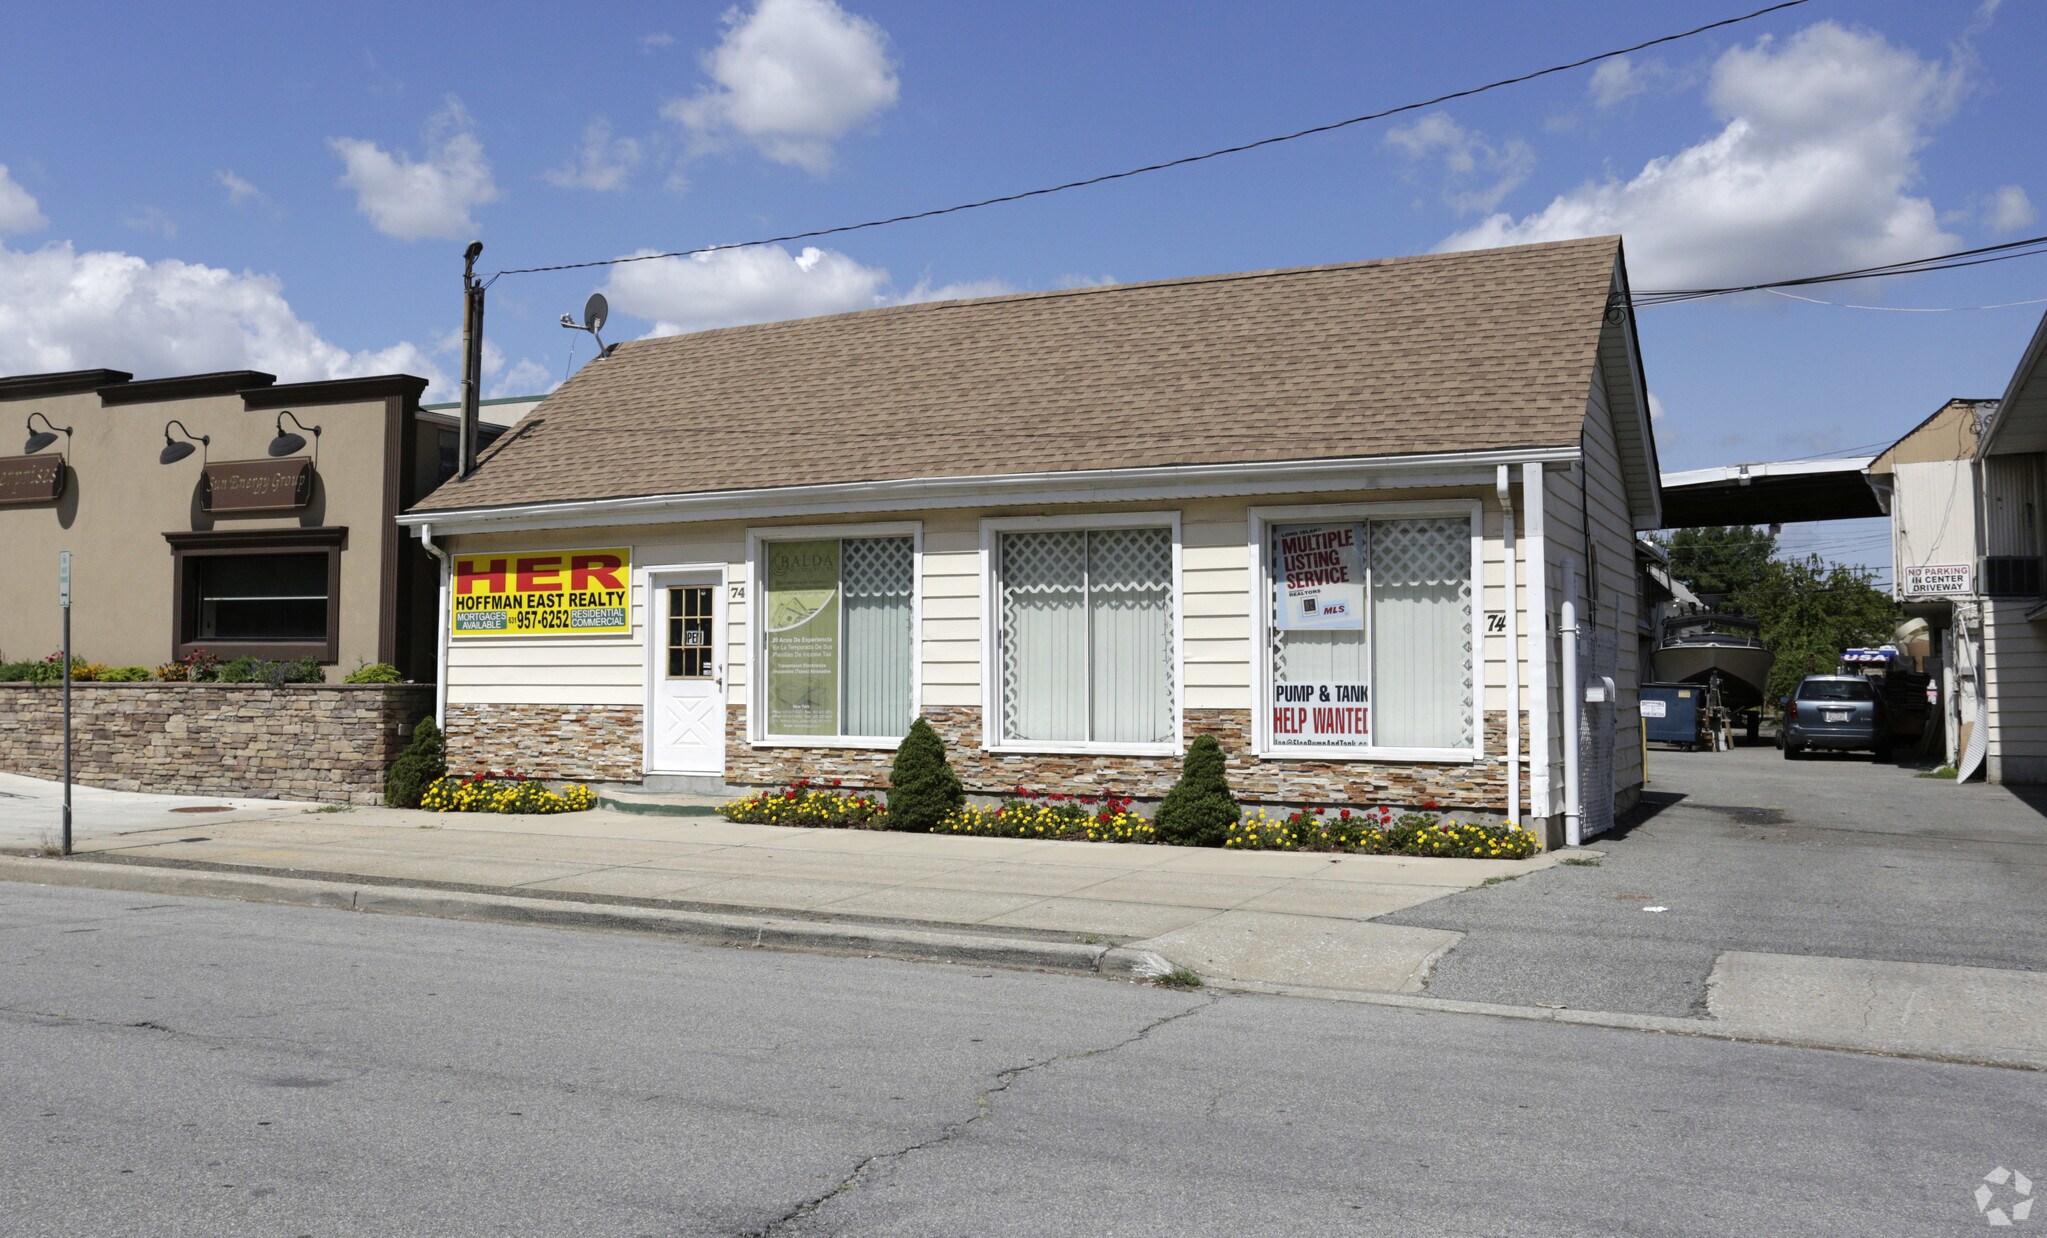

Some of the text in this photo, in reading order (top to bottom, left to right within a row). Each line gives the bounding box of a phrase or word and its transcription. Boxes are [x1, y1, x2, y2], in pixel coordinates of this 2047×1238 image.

[206, 472, 306, 494] Sun Energy Group
[1281, 530, 1299, 538] LONG
[1281, 528, 1354, 555] MULTIPLE
[780, 553, 833, 568] BALDA
[1283, 549, 1340, 573] LISTING
[456, 554, 626, 595] HER
[1286, 565, 1350, 590] SERVICE
[1908, 566, 1968, 576] NO PARKING
[1925, 574, 1964, 583] CENTER
[730, 587, 746, 600] 74
[1288, 588, 1321, 597] REALTORS
[1913, 583, 1963, 592] DRIVEWAY
[456, 591, 626, 611] HOFFMAN EAST REALTY
[456, 611, 507, 622] MORTGAGES
[571, 608, 624, 619] RESIDENTIAL
[1323, 605, 1345, 615] MLS
[461, 620, 502, 631] AVAILABLE
[517, 609, 570, 630] 957-6252
[571, 616, 625, 628] COMMERCIAL
[1487, 614, 1506, 632] 74
[1844, 654, 1886, 662] USA
[1276, 685, 1368, 702] PUMP & TANK
[1274, 707, 1368, 734] HELP WANTED
